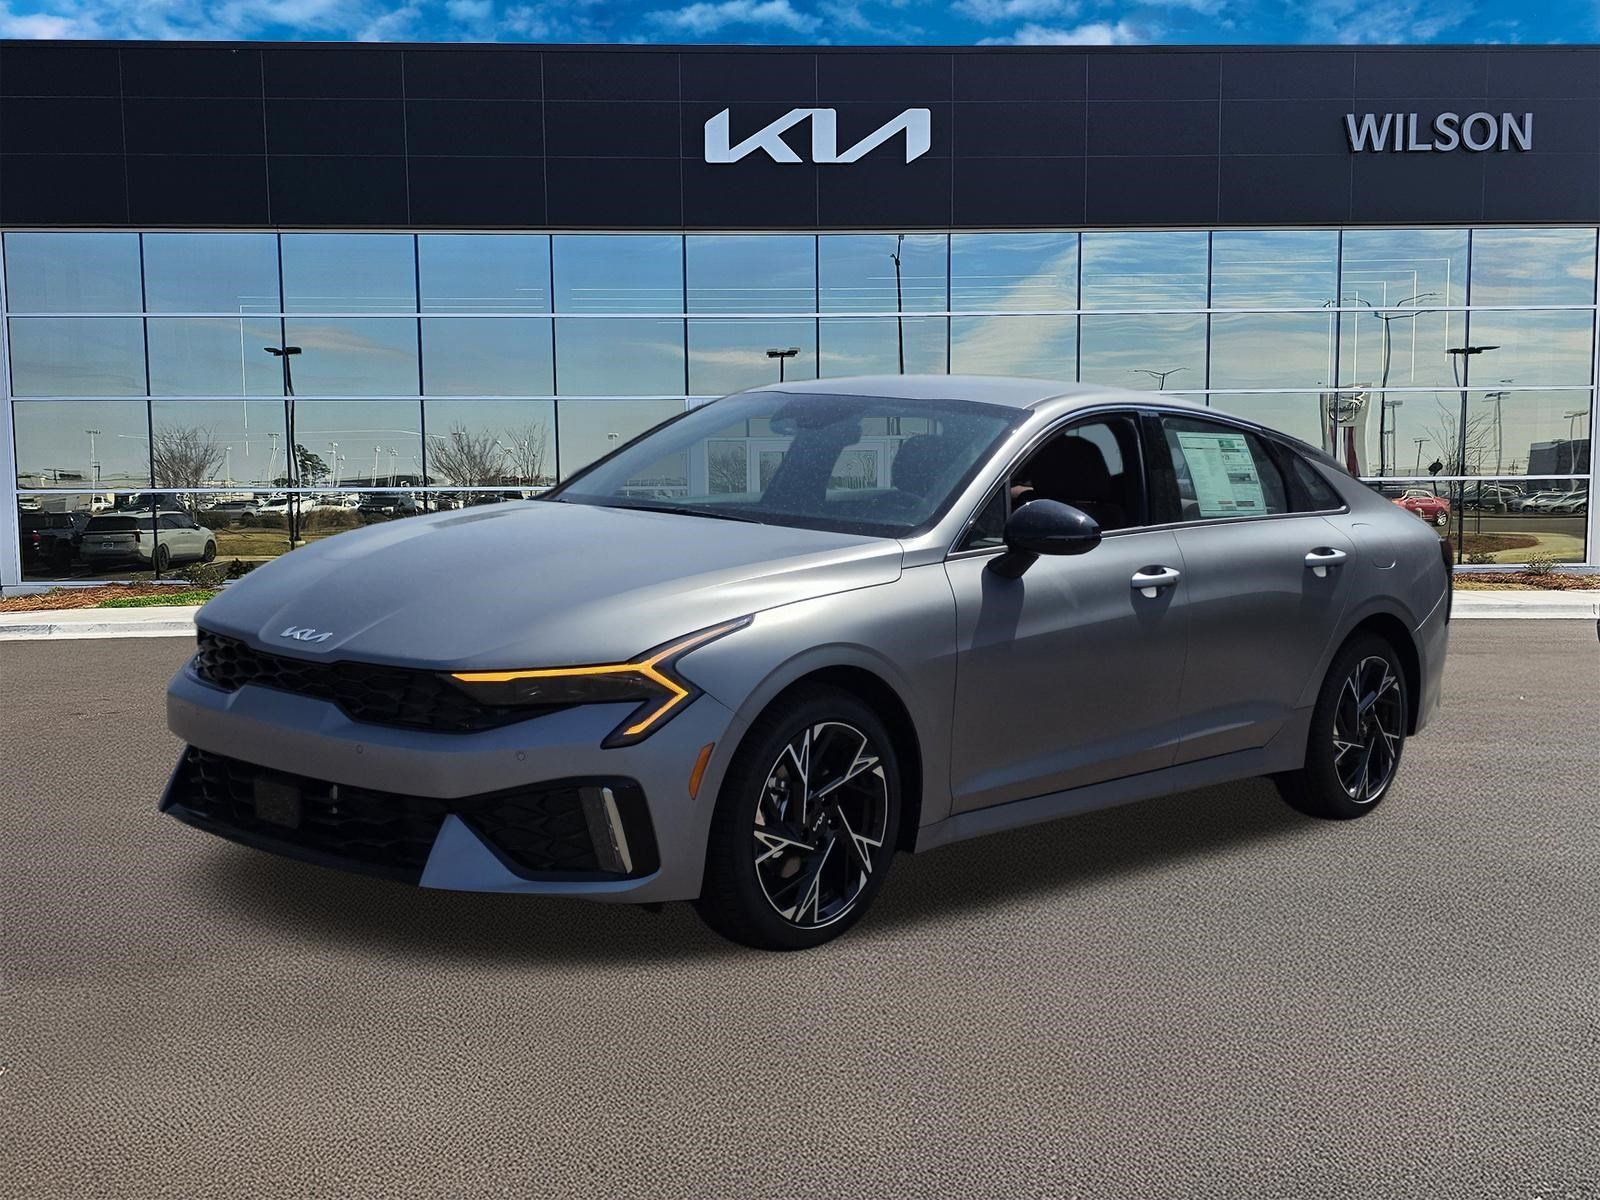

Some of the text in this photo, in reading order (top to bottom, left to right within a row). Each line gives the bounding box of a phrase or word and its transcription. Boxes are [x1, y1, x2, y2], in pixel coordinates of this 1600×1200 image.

[704, 107, 931, 164] KIA
[1345, 111, 1534, 152] WILSON
[280, 626, 333, 643] KIA
